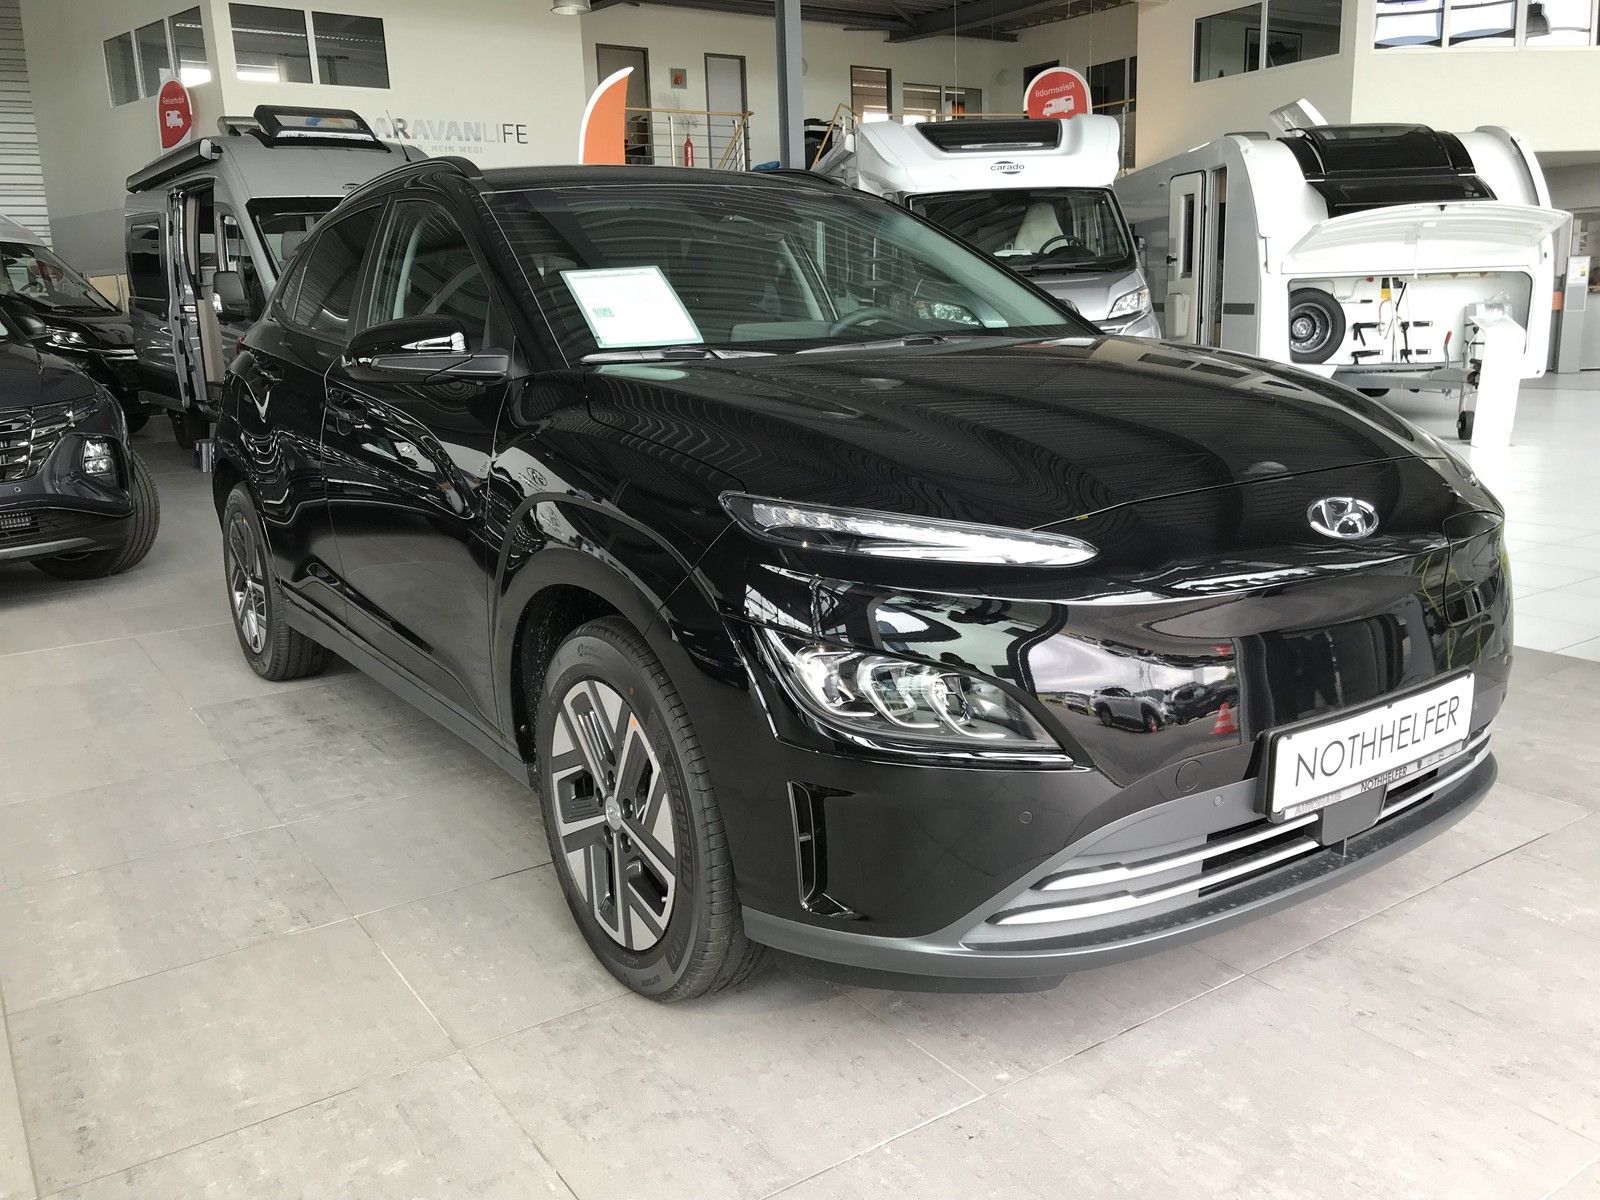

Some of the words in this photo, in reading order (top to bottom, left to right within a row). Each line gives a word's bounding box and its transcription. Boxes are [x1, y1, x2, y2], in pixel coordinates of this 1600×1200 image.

[373, 117, 528, 144] ARAVANLIFE
[990, 163, 1025, 171] carado
[1295, 696, 1460, 787] NOTHHELFER
[1360, 766, 1408, 793] NOTHHELFER
